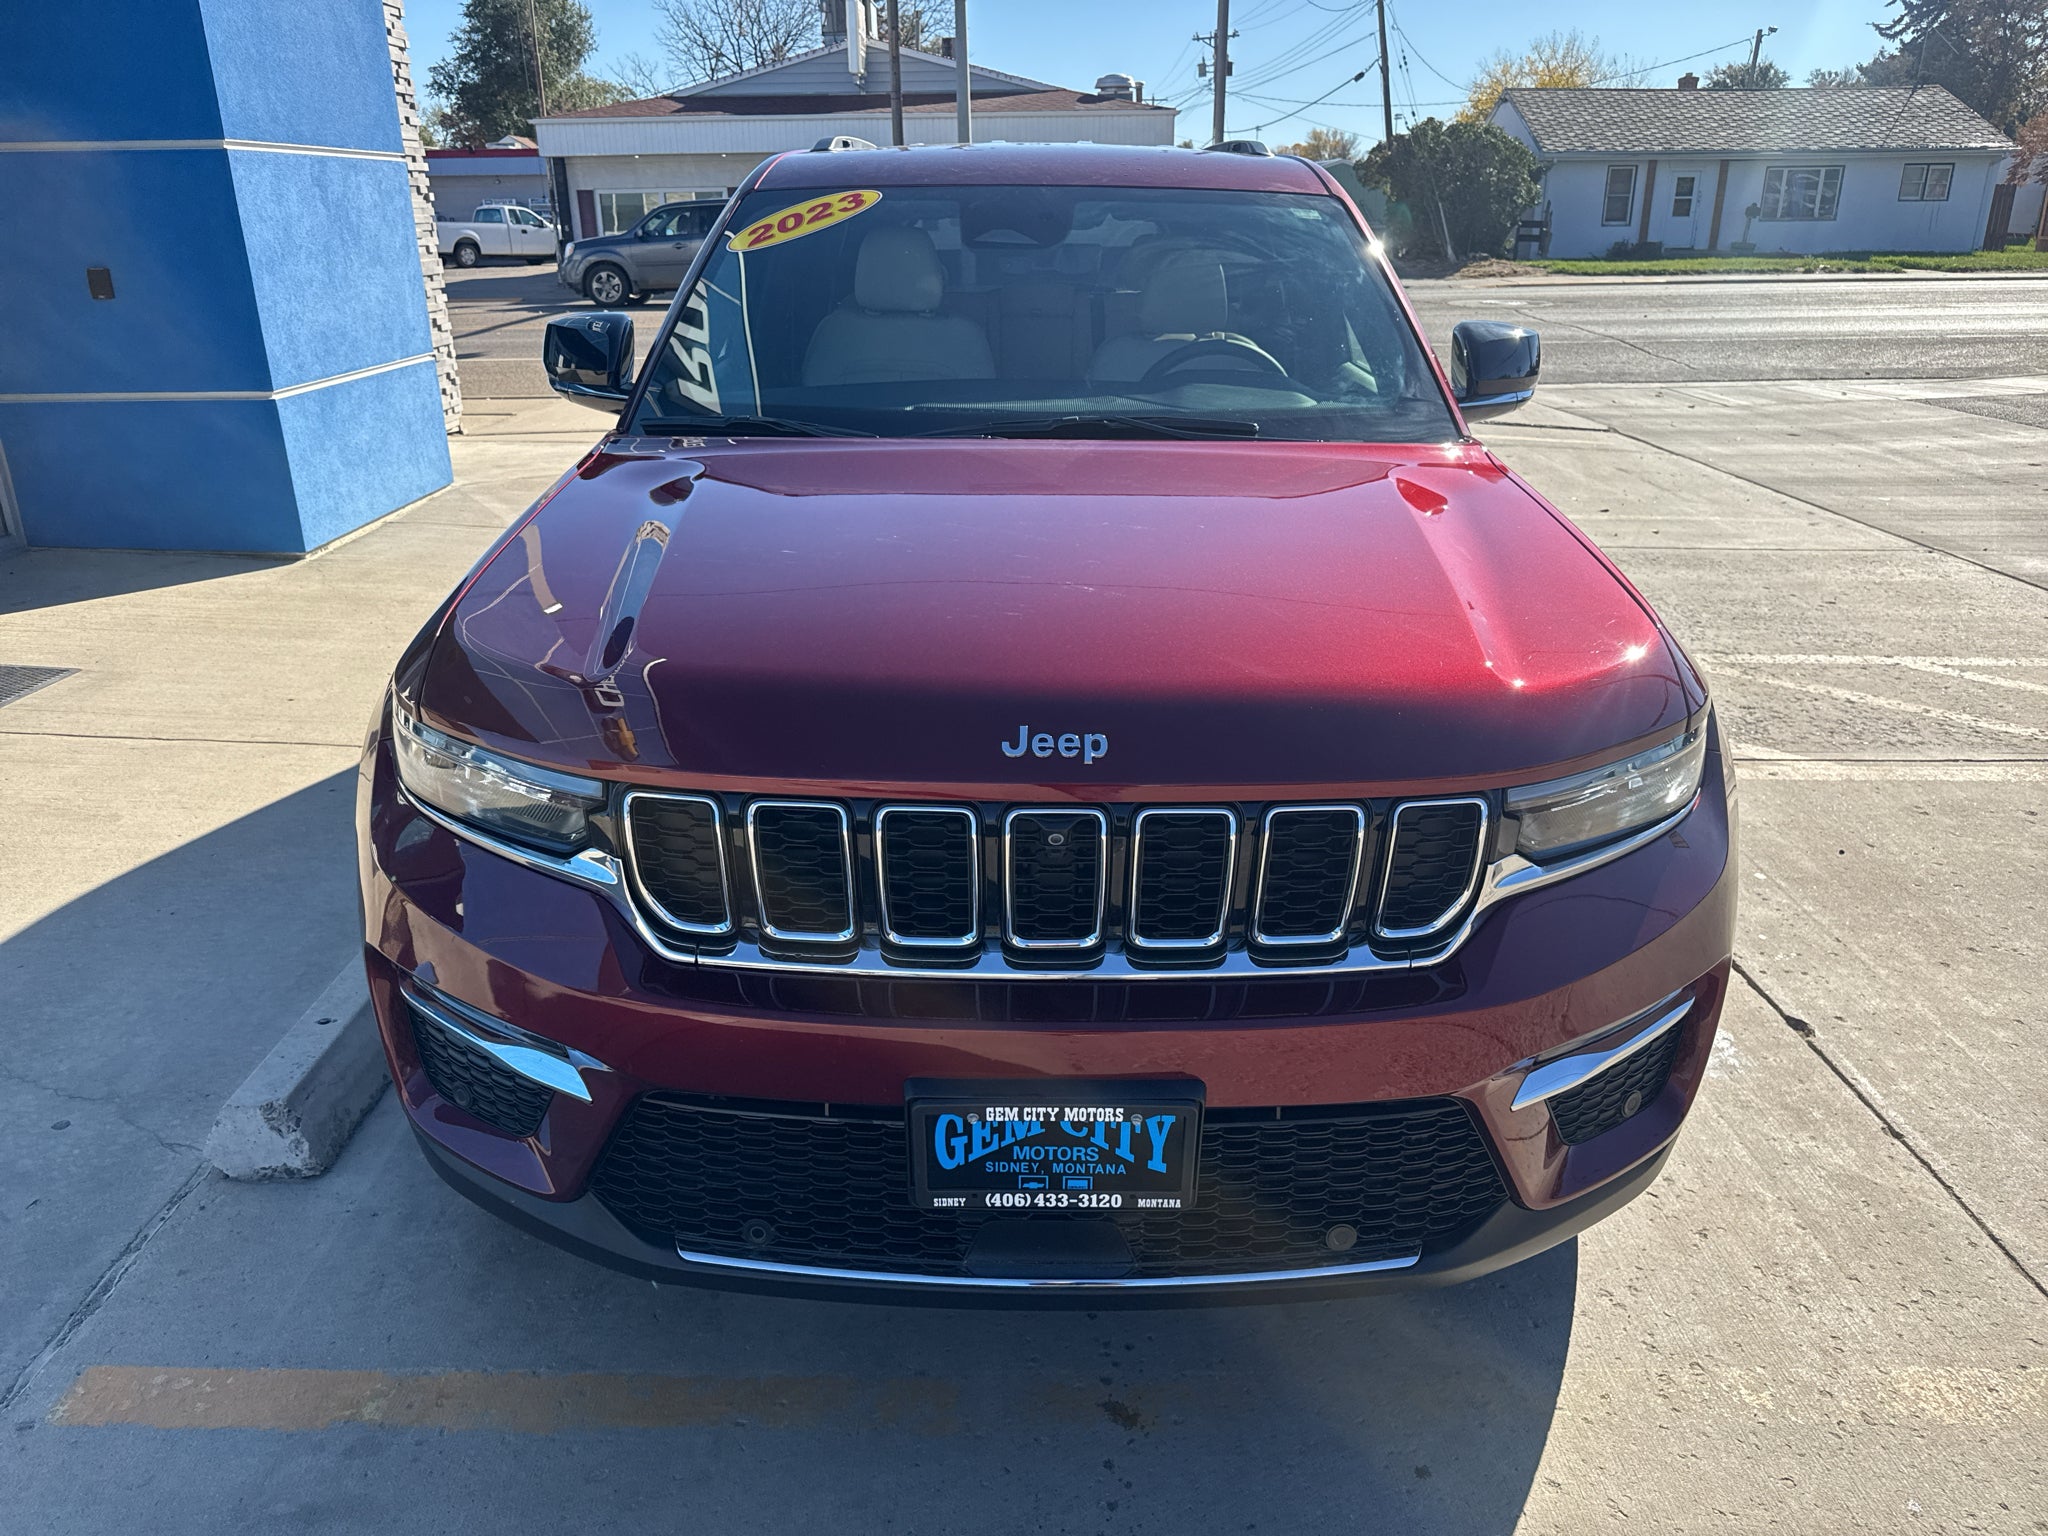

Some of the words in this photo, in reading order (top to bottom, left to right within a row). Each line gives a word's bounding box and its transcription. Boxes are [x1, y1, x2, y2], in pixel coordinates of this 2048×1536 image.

[747, 193, 866, 248] 2023
[1001, 725, 1108, 765] Jeep
[985, 1107, 1019, 1122] GEM
[1023, 1107, 1059, 1122] CITY
[1064, 1107, 1124, 1122] MOTORS
[934, 1113, 1046, 1170] GEM
[1012, 1145, 1099, 1161] MOTORS
[985, 1161, 1045, 1175] SIDNEY,
[1052, 1163, 1127, 1175] MONTANA
[933, 1197, 966, 1207] SIDNEY
[1137, 1198, 1182, 1208] MONTANA
